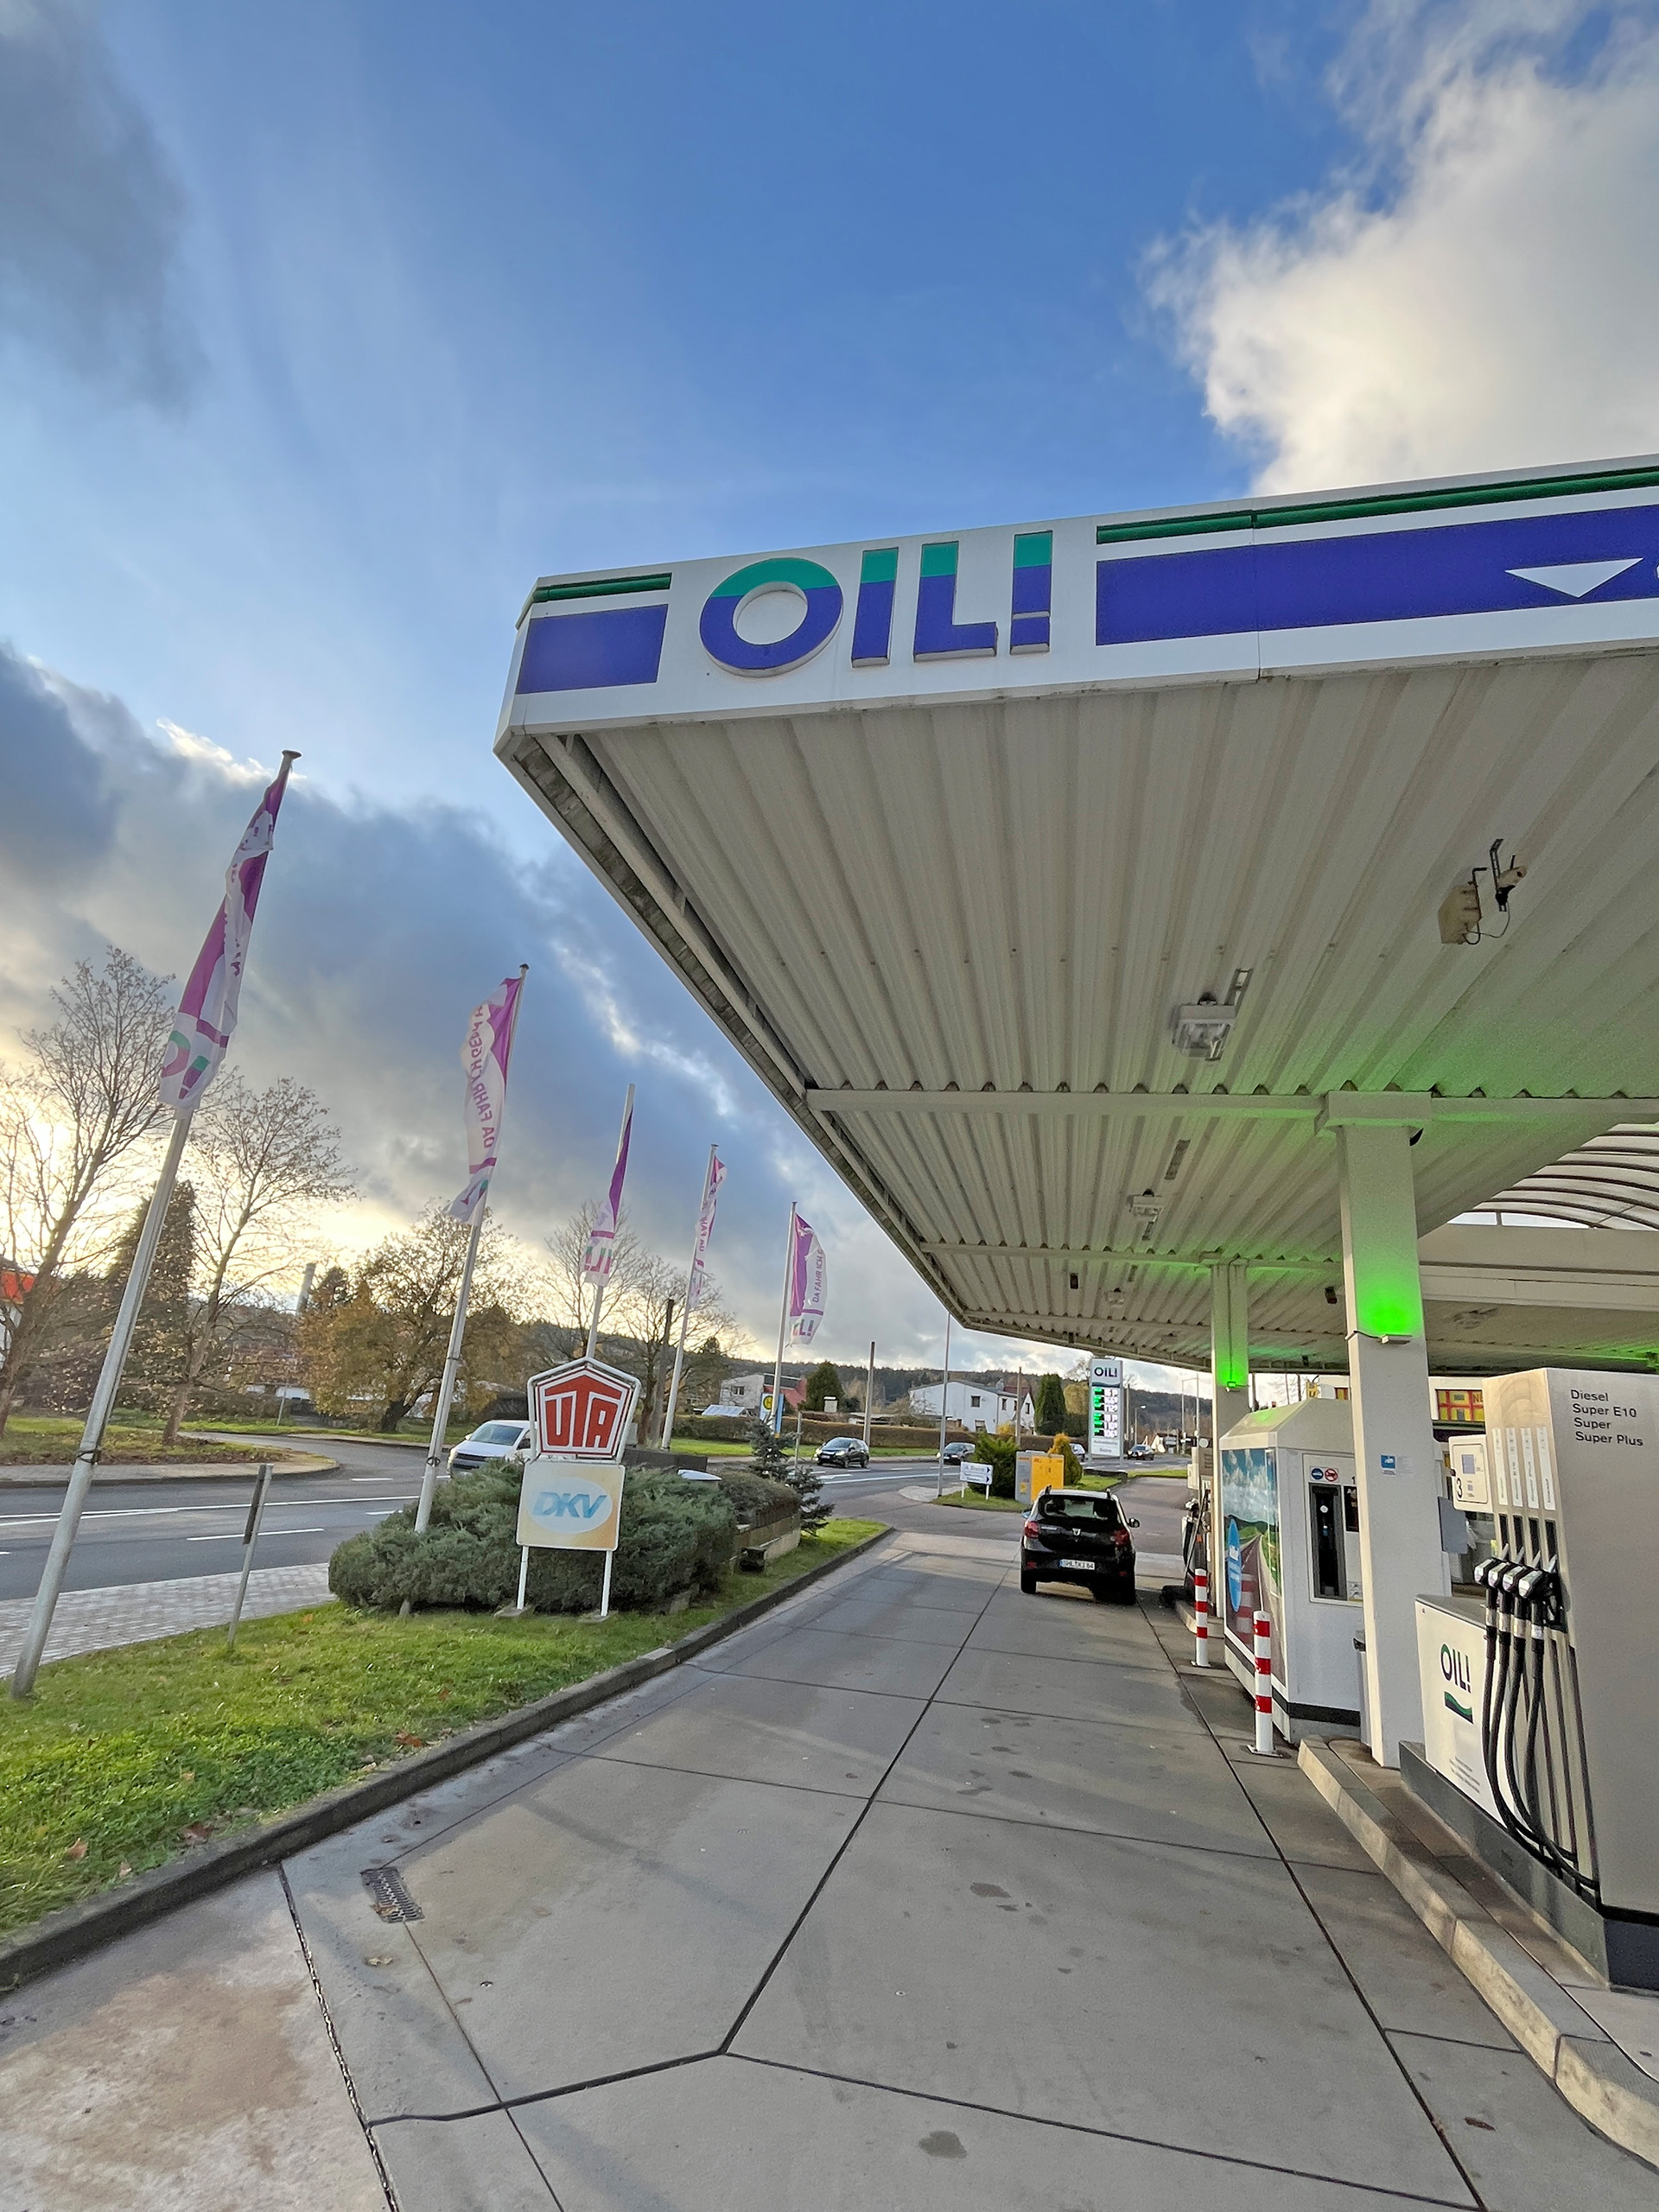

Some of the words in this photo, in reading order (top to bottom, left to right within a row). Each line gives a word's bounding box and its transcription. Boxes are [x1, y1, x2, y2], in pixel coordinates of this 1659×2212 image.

[700, 530, 1053, 677] OIL!
[814, 1269, 823, 1291] FAHR
[1094, 1367, 1117, 1377] OIL!
[1571, 1389, 1609, 1402] Diesel
[544, 1374, 624, 1449] UTA
[1573, 1403, 1610, 1416] Super
[1613, 1406, 1637, 1418] E10
[1574, 1417, 1611, 1430] Super
[1575, 1431, 1613, 1444] Super
[1617, 1434, 1643, 1446] Plus
[1456, 1478, 1463, 1498] 3
[532, 1491, 607, 1518] DKV
[1440, 1643, 1471, 1694] OIL!
